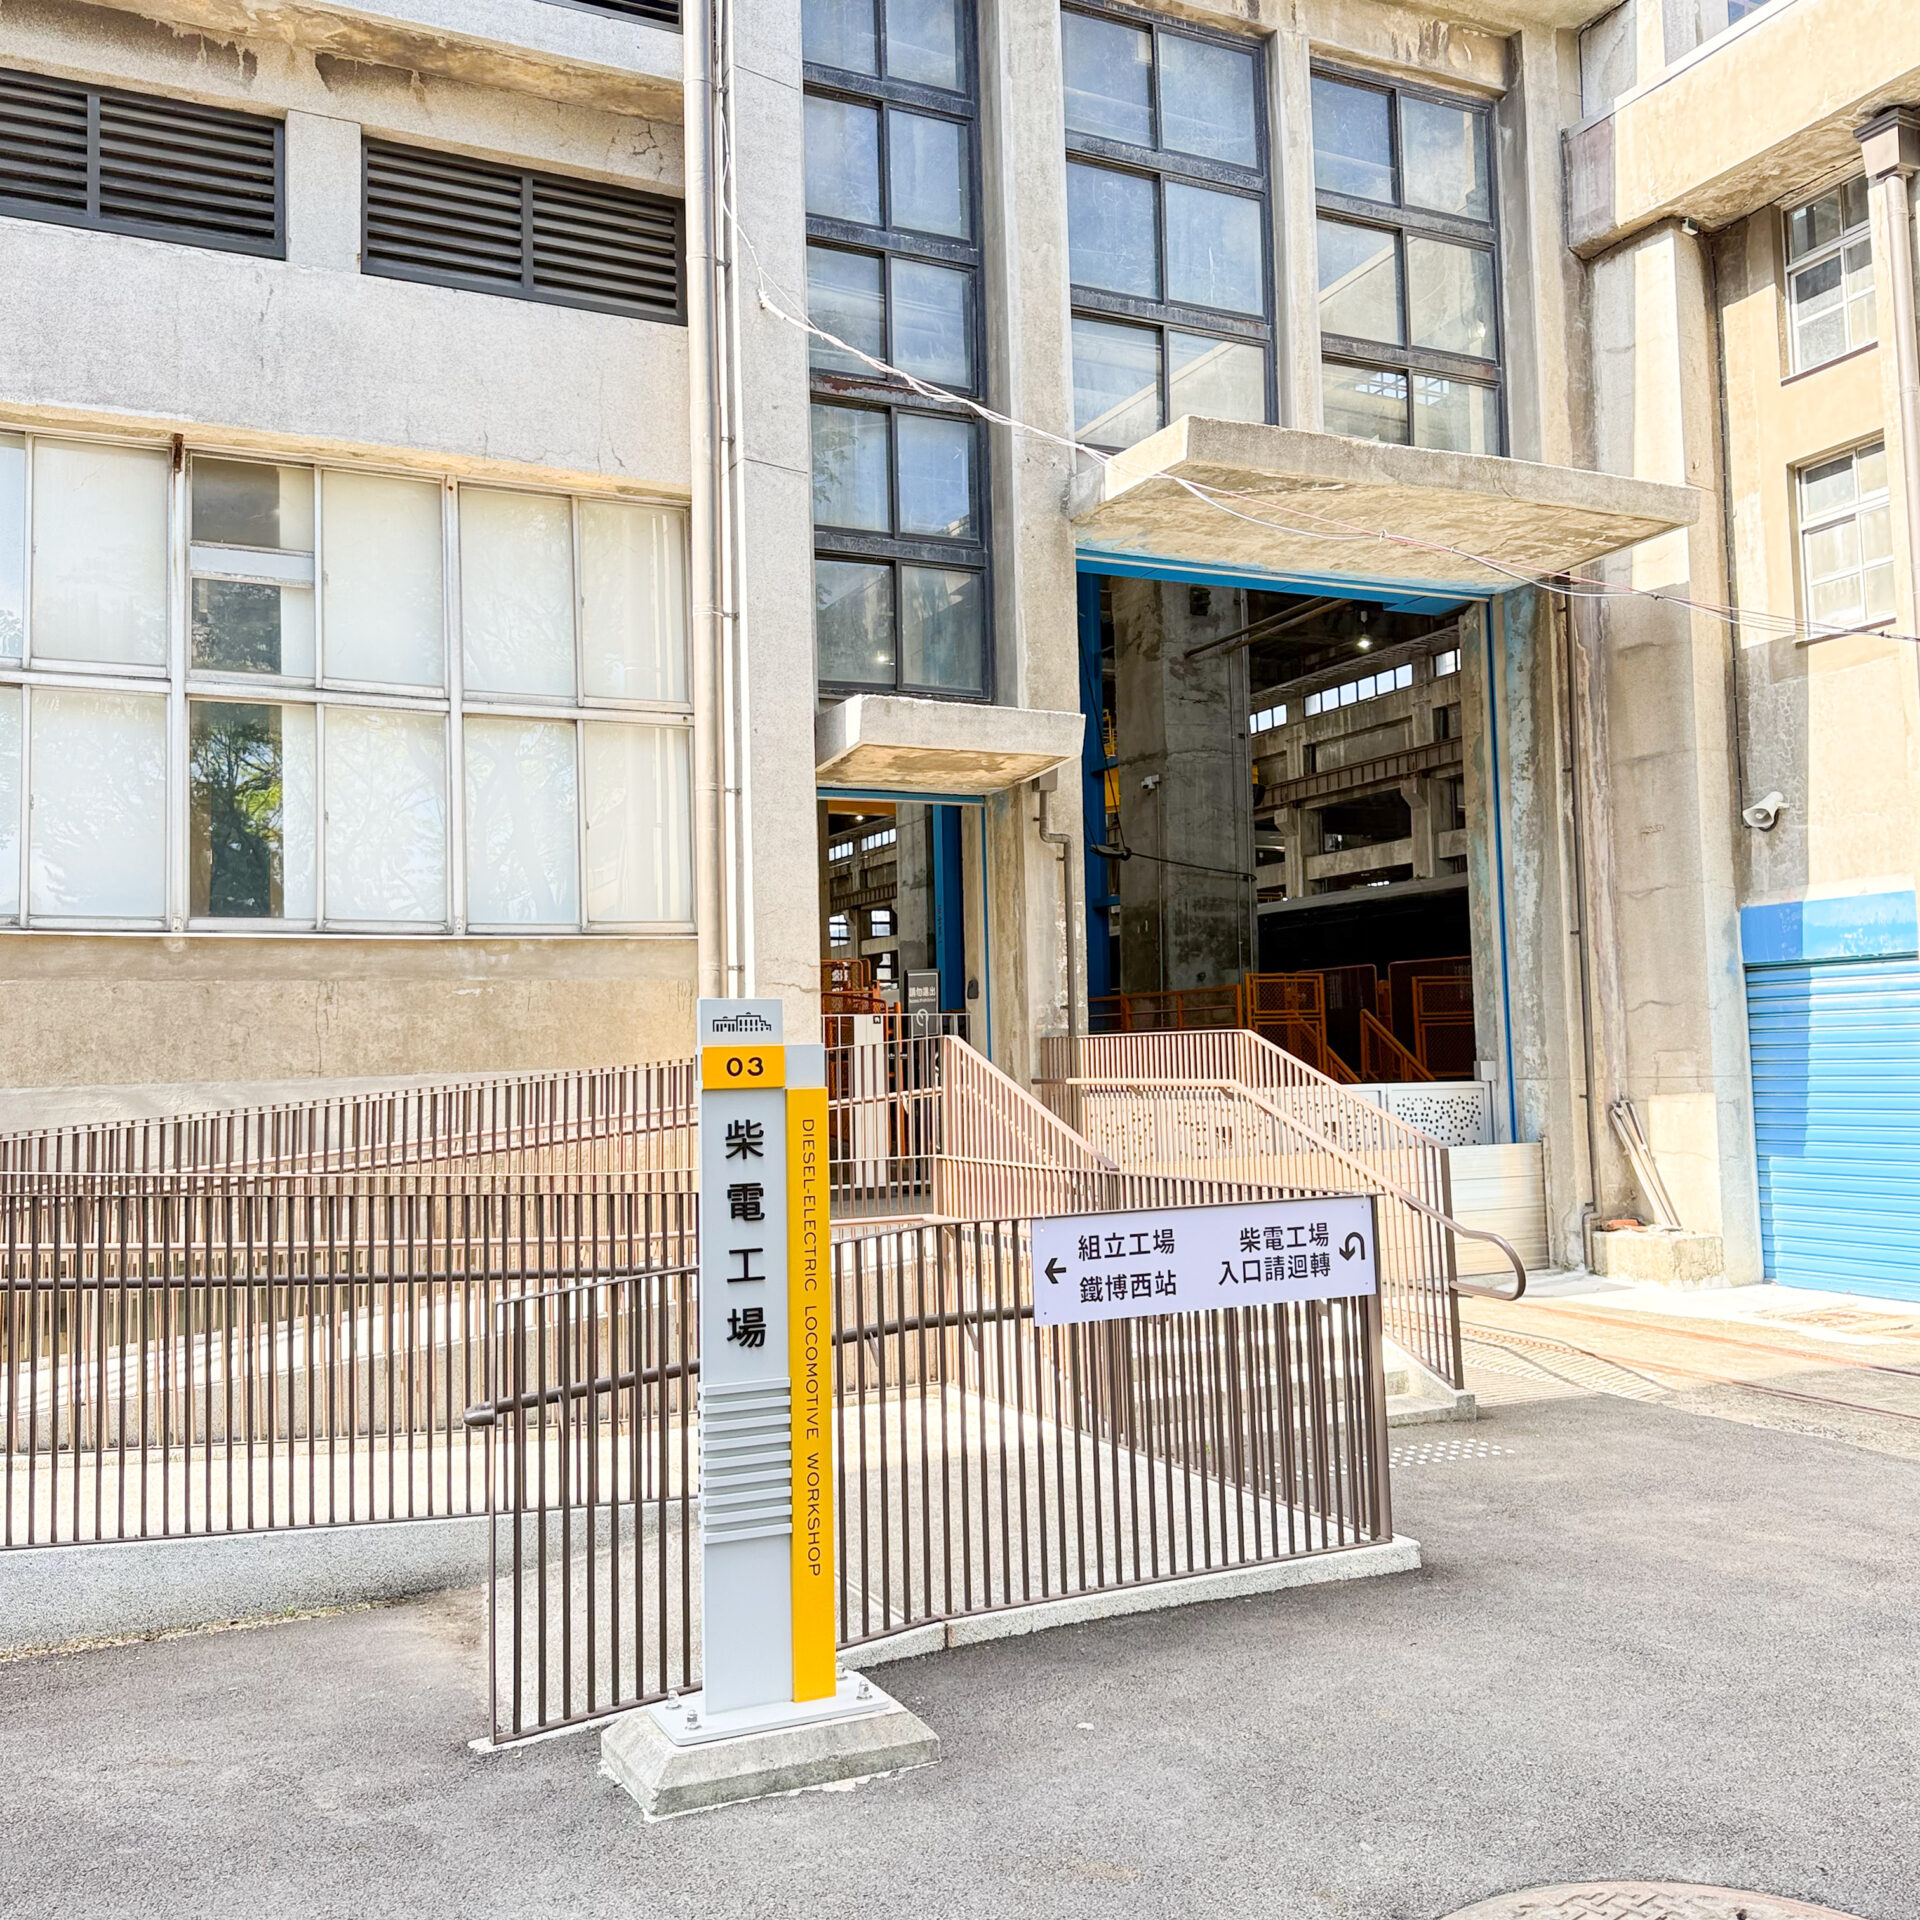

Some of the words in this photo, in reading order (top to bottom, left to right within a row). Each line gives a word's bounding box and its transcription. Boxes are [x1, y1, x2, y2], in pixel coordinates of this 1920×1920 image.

[726, 1056, 764, 1077] 03
[802, 1119, 817, 1292] DIESEL-ELECTRIC
[725, 1119, 767, 1349] 柴電工場
[1078, 1228, 1175, 1262] 組立工場
[1239, 1222, 1330, 1253] 柴電工場
[1218, 1251, 1331, 1286] 入口請迴轉
[1079, 1269, 1177, 1304] 鐵博西站
[804, 1305, 819, 1440] LOCOMOTIVE
[806, 1452, 821, 1576] WORKSHOP
